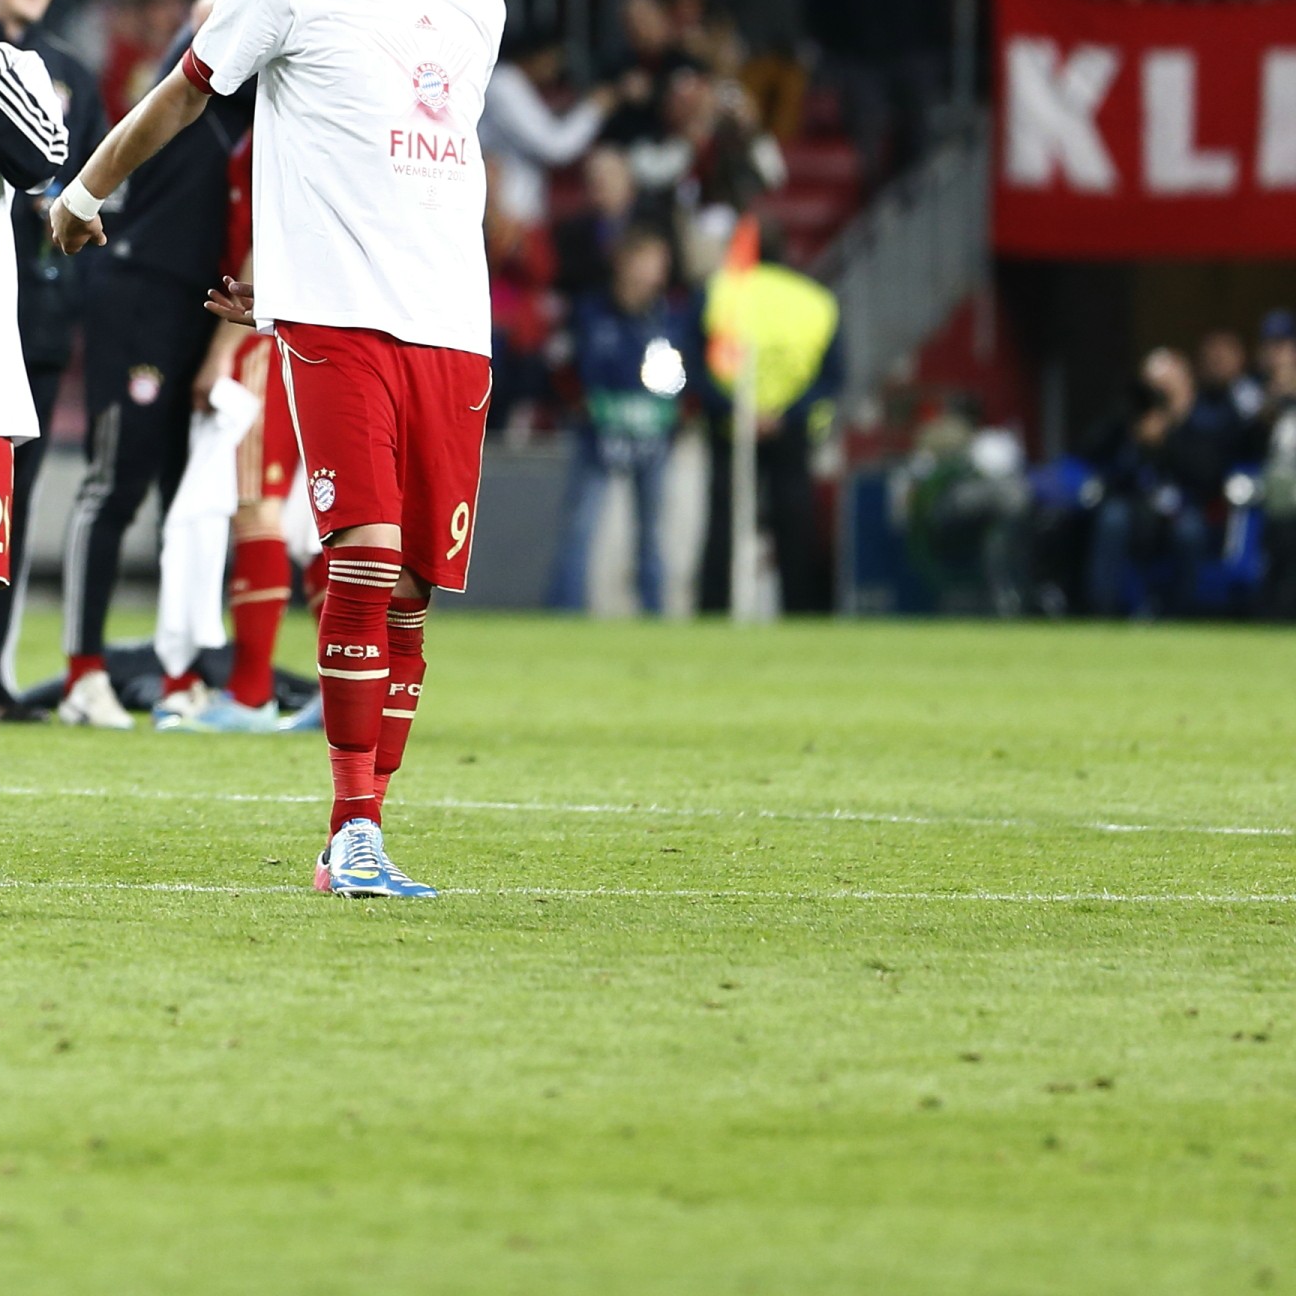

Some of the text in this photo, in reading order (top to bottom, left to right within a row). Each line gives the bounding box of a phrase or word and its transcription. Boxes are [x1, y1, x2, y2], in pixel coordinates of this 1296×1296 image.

[390, 129, 466, 165] FINAL
[393, 163, 445, 179] WEMBLEY
[446, 501, 470, 561] 9
[326, 643, 382, 660] FCB
[388, 682, 425, 697] FC
